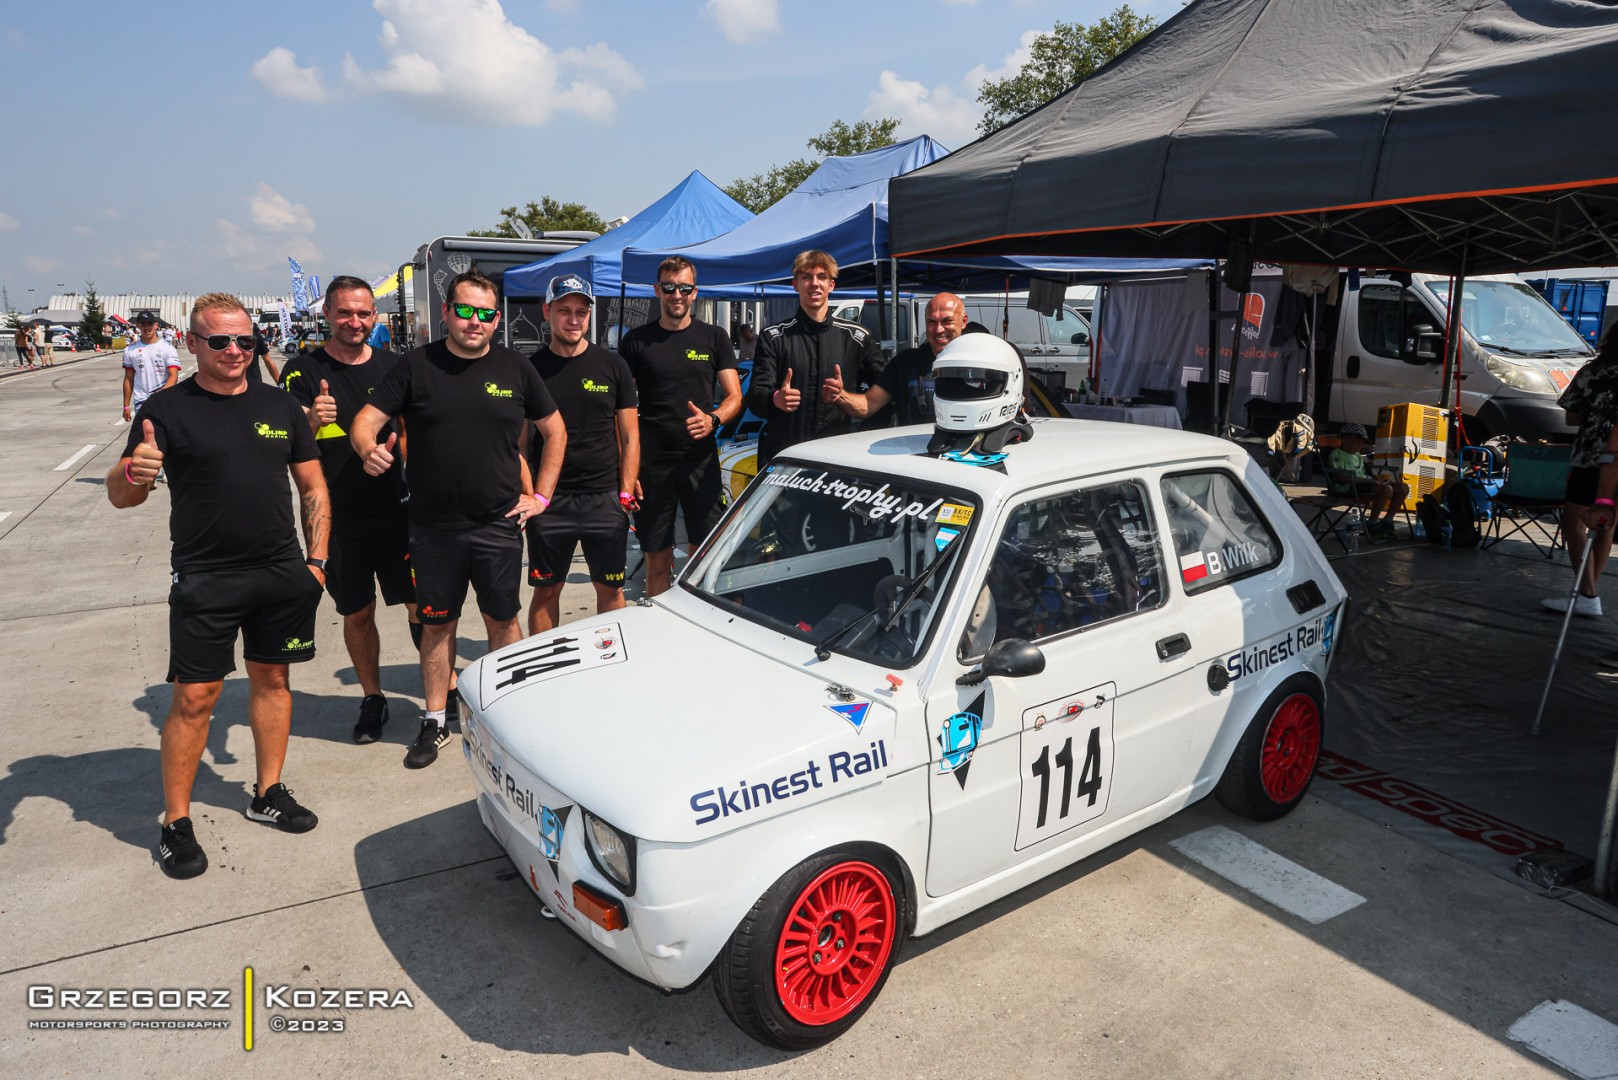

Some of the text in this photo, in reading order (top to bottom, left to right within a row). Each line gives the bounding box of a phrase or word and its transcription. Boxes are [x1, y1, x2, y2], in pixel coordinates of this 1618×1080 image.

[762, 468, 943, 524] maluch-trophy.pl
[495, 637, 580, 691] 114
[1227, 618, 1322, 682] Skinest Rail
[469, 731, 535, 818] Skinest Rail
[689, 739, 888, 827] Skinest Rail
[1031, 726, 1103, 829] 114
